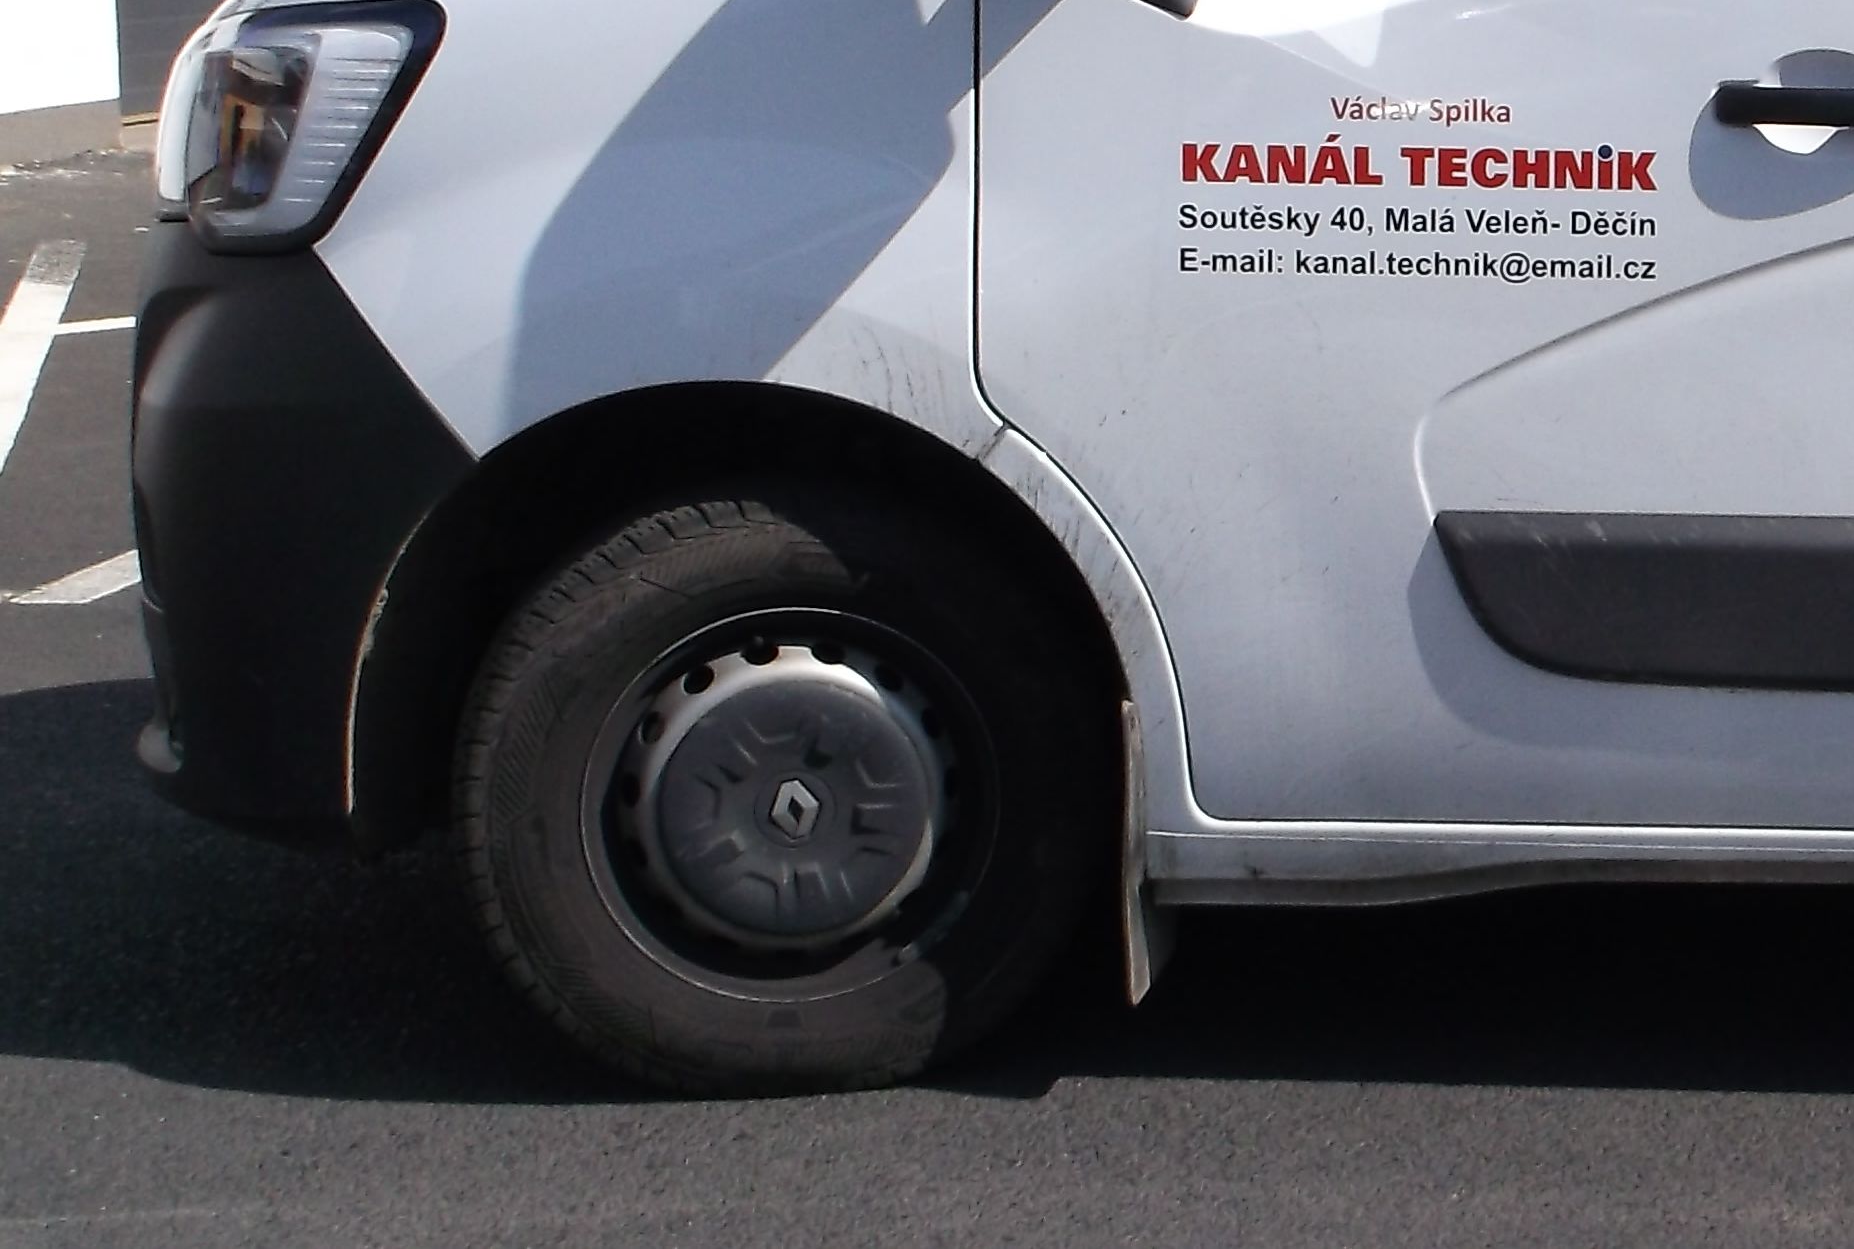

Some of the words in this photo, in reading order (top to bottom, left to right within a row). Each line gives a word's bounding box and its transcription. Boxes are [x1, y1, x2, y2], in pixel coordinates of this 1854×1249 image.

[1330, 97, 1421, 121] Václav
[1430, 98, 1511, 127] Spilka
[1182, 134, 1383, 186] KANÁL
[1179, 204, 1320, 237] Soutěsky
[1331, 207, 1374, 236] 40,
[1386, 209, 1455, 234] Malá
[1570, 212, 1657, 237] Děčín
[1180, 249, 1285, 274] E-mail:
[1297, 251, 1657, 284] kanal.technik@email.cz
